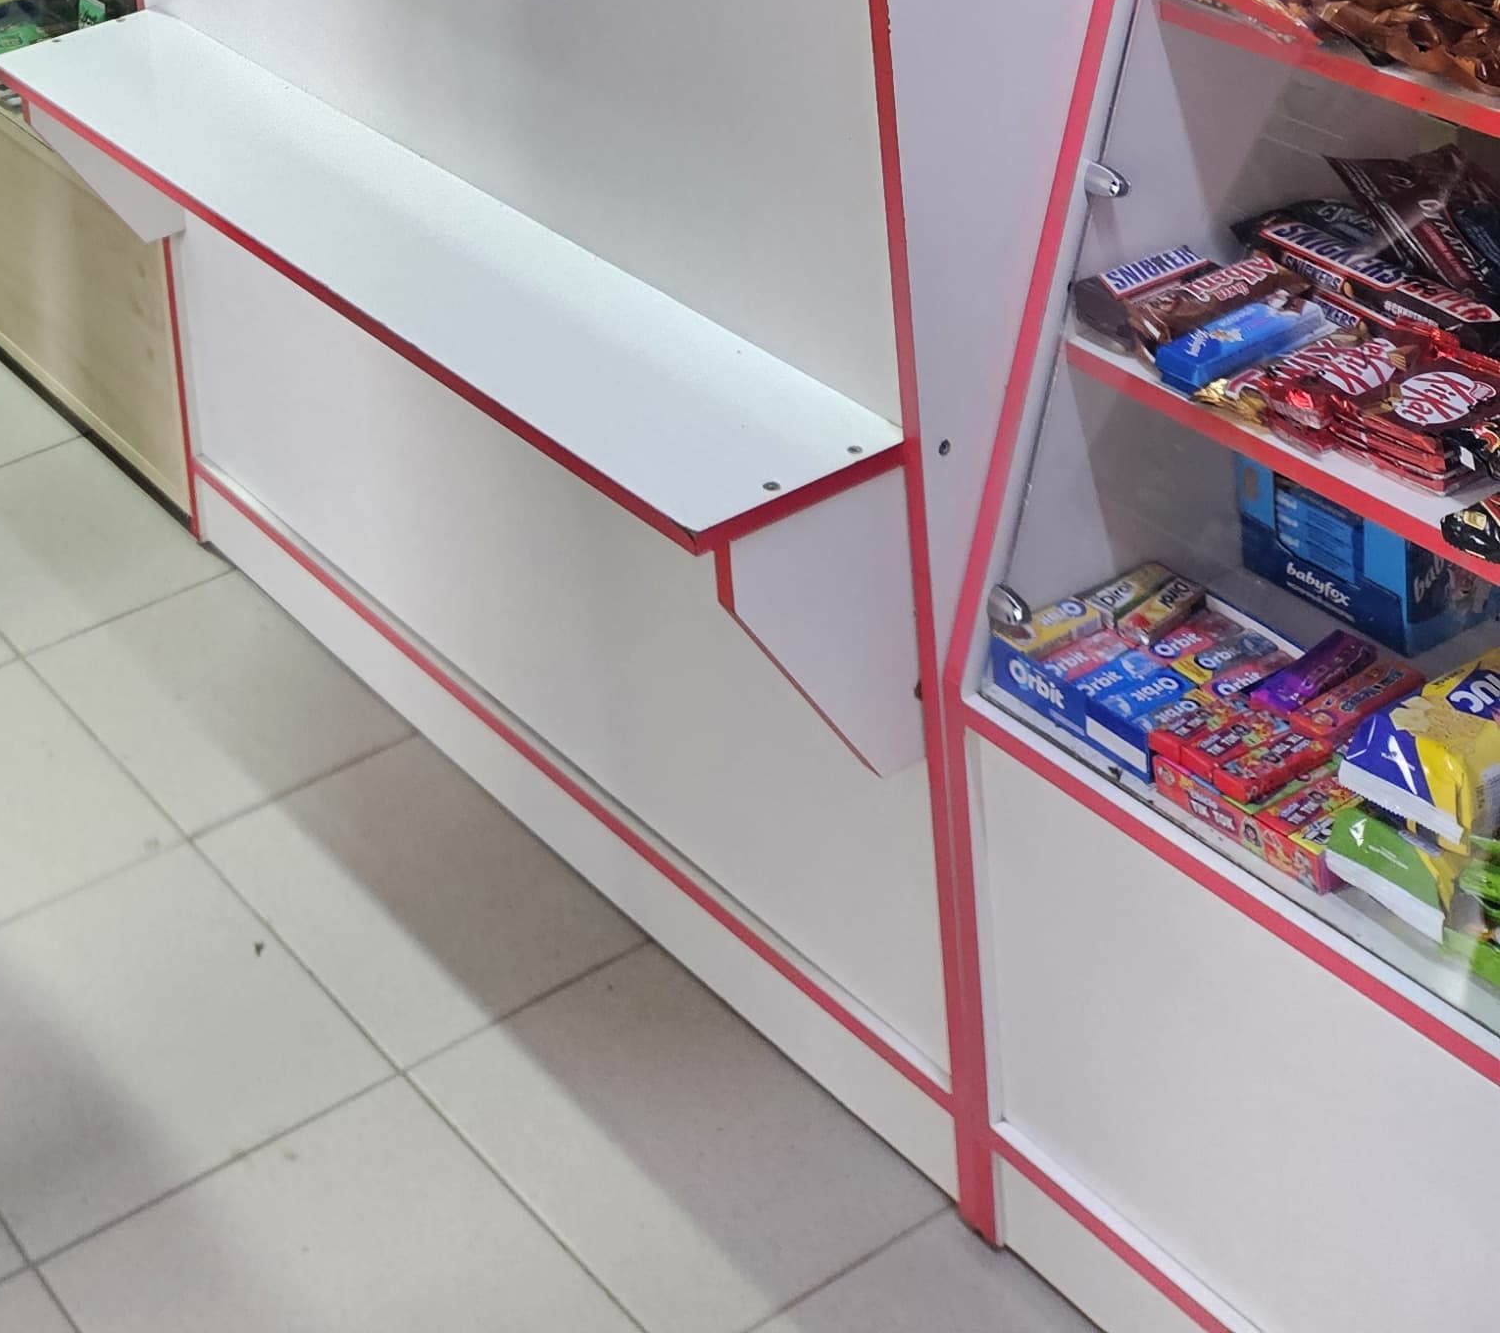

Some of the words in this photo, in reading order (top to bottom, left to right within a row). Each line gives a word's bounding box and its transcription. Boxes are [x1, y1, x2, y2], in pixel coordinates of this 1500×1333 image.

[1286, 562, 1351, 607] babyfox
[1152, 631, 1204, 659] Orbit
[1008, 658, 1066, 710] Orbit
